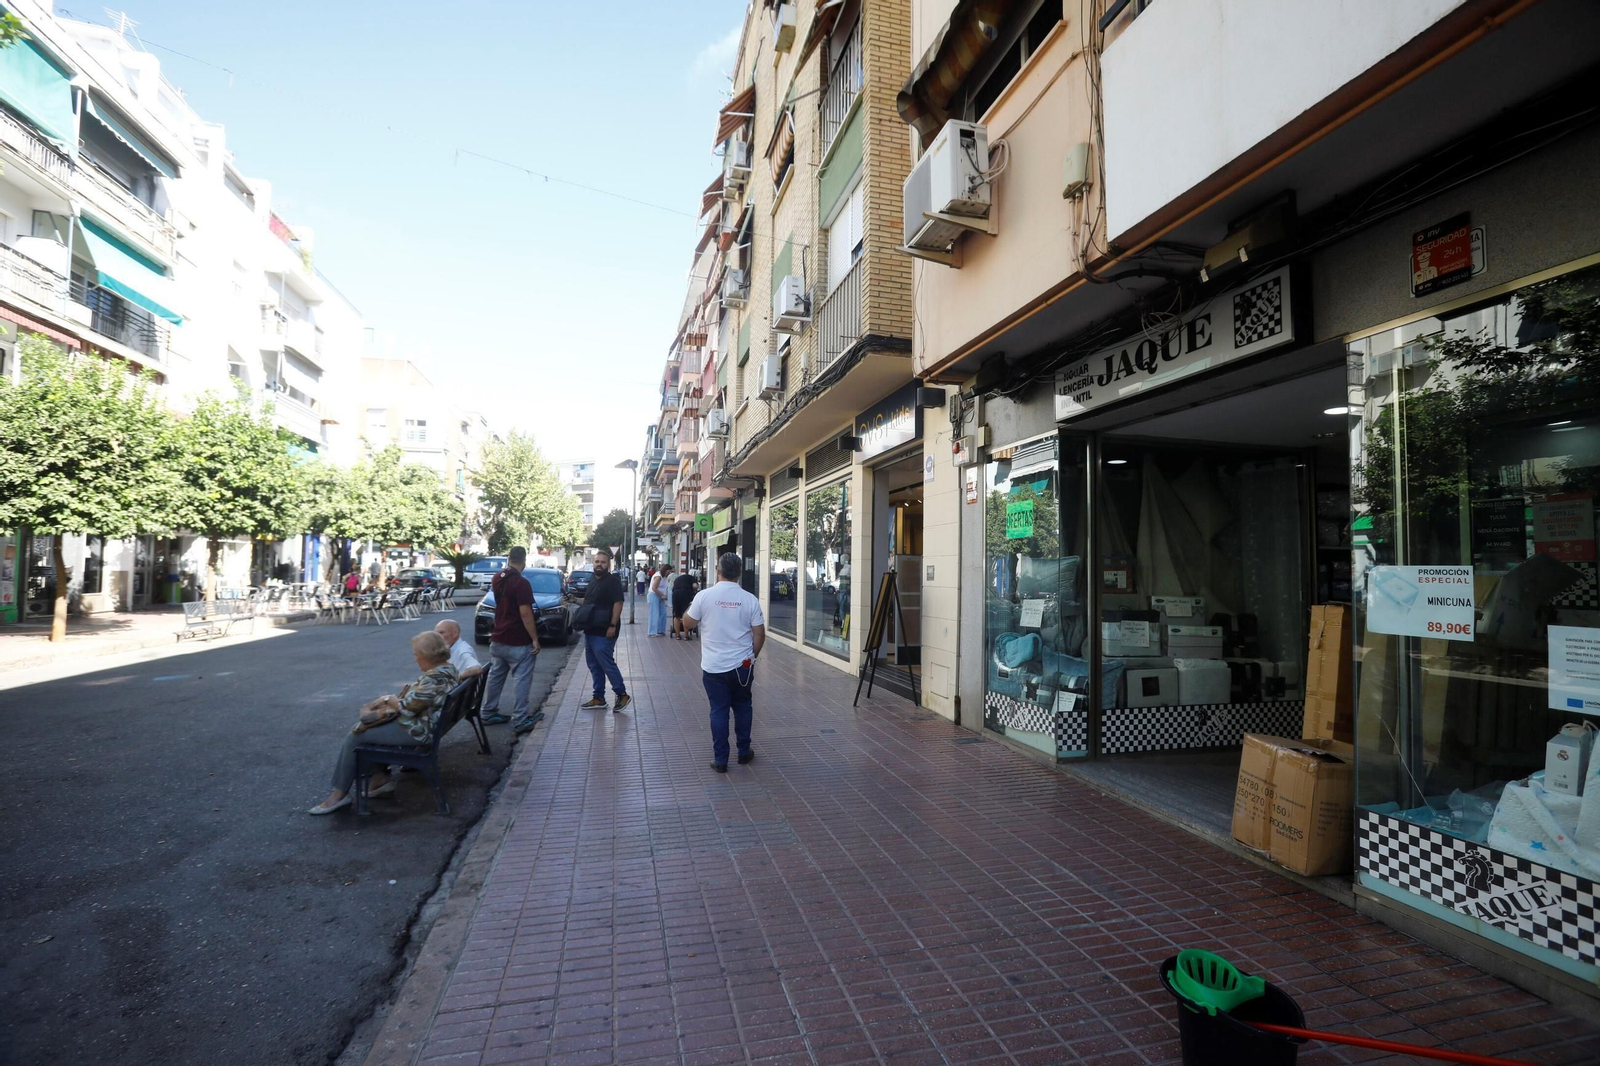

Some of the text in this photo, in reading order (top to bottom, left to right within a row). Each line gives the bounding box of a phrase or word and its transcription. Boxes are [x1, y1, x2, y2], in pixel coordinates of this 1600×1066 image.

[1416, 228, 1467, 254] SEGURIDAD
[1236, 288, 1280, 346] JAQUE
[1097, 313, 1212, 386] JAQUE
[1063, 363, 1088, 382] HOGAR
[1059, 374, 1094, 396] LENCERÍA
[1061, 390, 1092, 409] INFANTIL
[859, 405, 910, 450] OVS kids
[1006, 510, 1034, 528] OFERTAS
[1428, 597, 1472, 607] MINICUNA
[1427, 621, 1471, 634] 89,90€
[1196, 713, 1227, 746] JAQUE
[1239, 775, 1259, 791] 54780
[1269, 816, 1303, 840] ROOMERS
